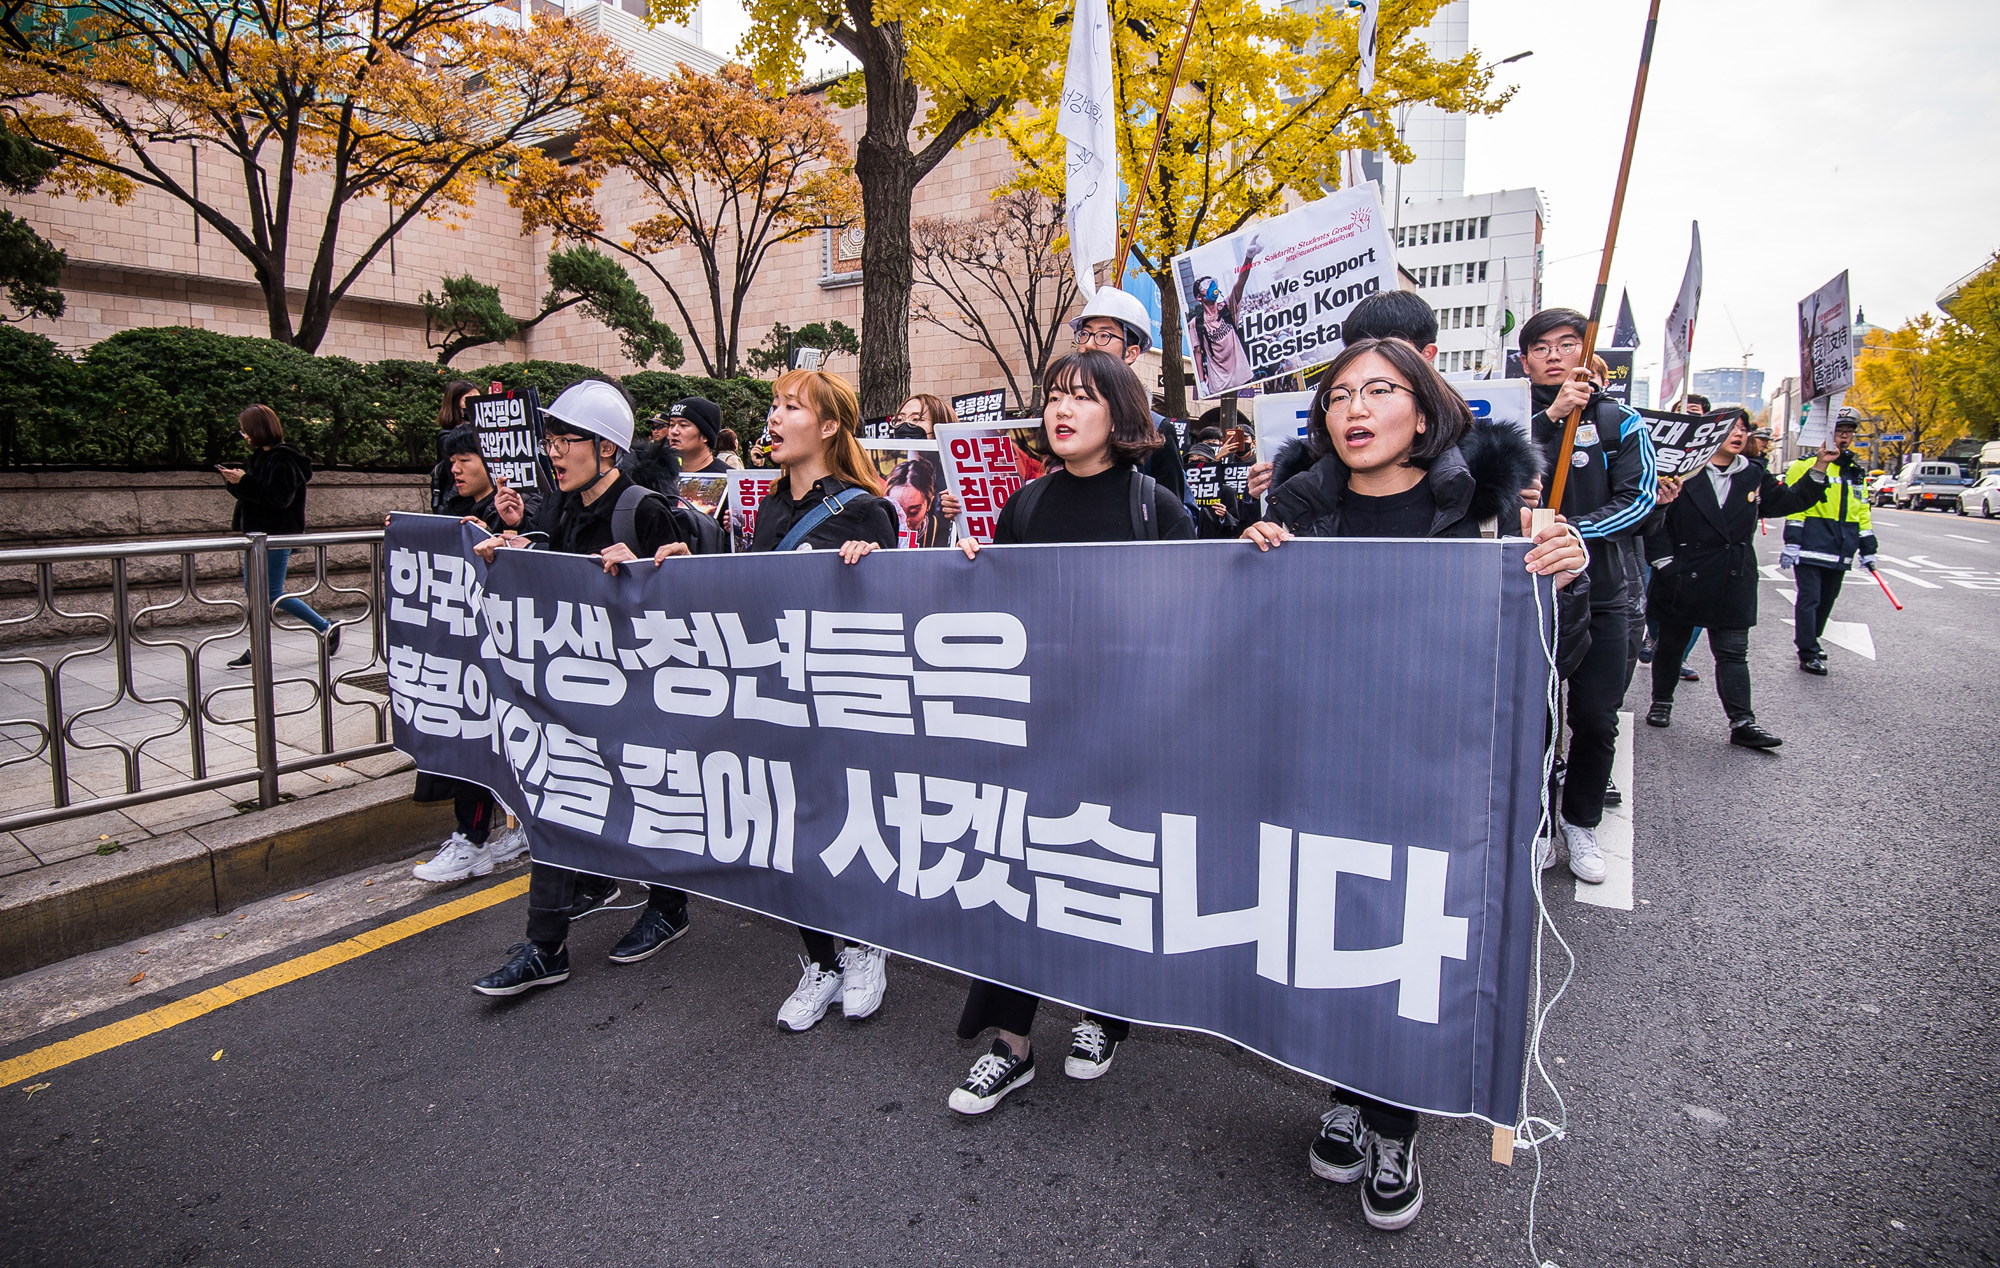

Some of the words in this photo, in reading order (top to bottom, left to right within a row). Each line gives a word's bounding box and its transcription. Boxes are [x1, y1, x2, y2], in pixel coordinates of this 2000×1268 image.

[1264, 245, 1296, 263] Solidarity
[1297, 232, 1330, 250] Students
[1331, 222, 1355, 237] Group
[1271, 278, 1299, 299] We
[1303, 247, 1376, 288] Support
[1245, 302, 1307, 339] Hong
[1251, 321, 1346, 367] Resista
[474, 398, 527, 428] 시진핑의
[955, 393, 1003, 416] 홍콩항쟁
[478, 430, 533, 458] 진압지시
[1685, 417, 1736, 448] 요구
[950, 436, 1017, 473] 인권
[1186, 466, 1217, 482] 요구
[958, 476, 1021, 512] 침해
[388, 644, 500, 755] 홍콩의
[496, 697, 614, 836] 민들
[619, 743, 796, 874] 곁에
[818, 767, 1469, 1024] 서겠습니다
